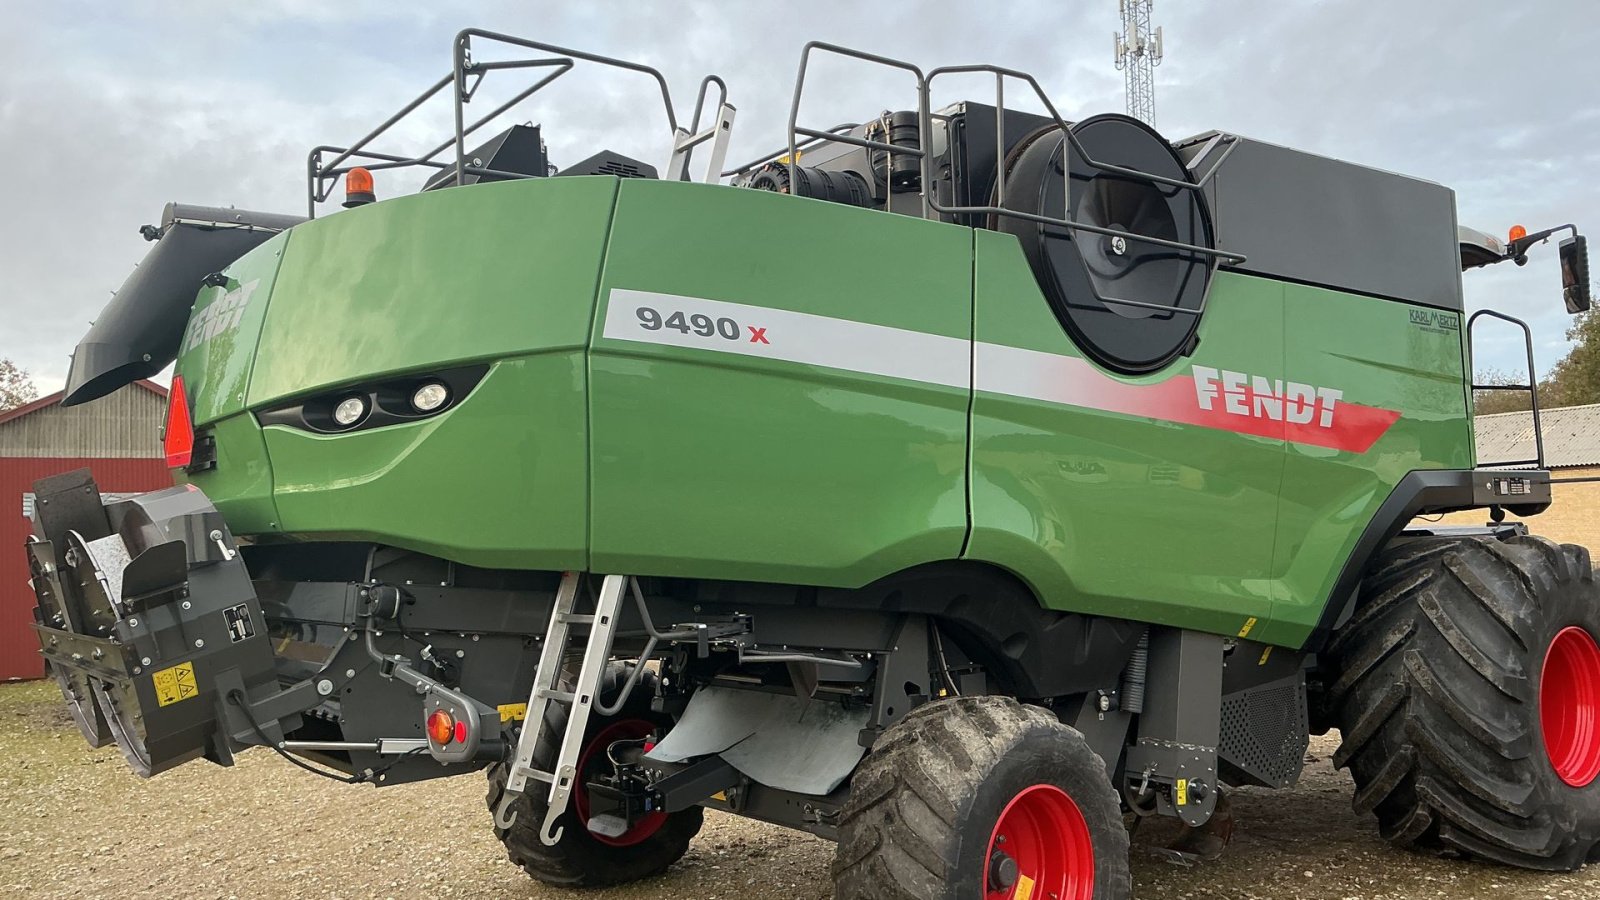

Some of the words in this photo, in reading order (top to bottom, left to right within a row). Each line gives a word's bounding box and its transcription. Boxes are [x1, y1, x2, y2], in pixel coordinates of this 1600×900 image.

[181, 278, 261, 354] FENDT
[635, 306, 740, 341] 9490
[1409, 310, 1430, 323] KARL
[1429, 311, 1459, 329] MERTZ
[1191, 364, 1344, 428] FENDT
